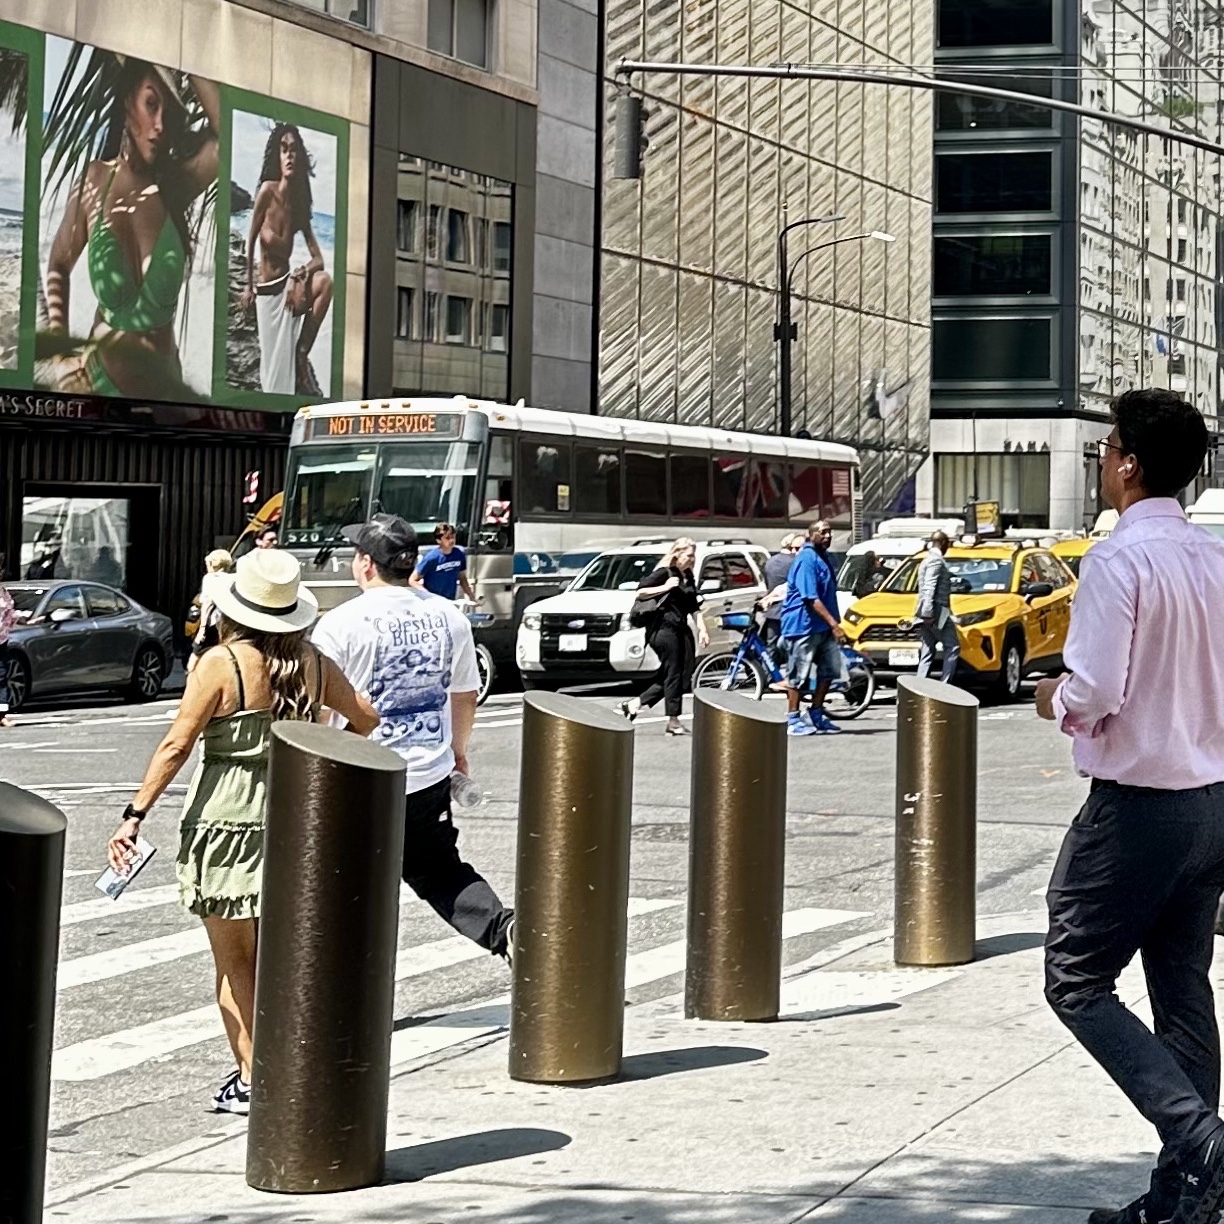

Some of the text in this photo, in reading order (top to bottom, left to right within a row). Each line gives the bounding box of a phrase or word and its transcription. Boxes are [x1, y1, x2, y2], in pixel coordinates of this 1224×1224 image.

[25, 396, 86, 418] SECRET
[328, 414, 437, 435] NOT IN SERVICE
[375, 610, 449, 634] Celestial
[393, 629, 439, 647] Blues
